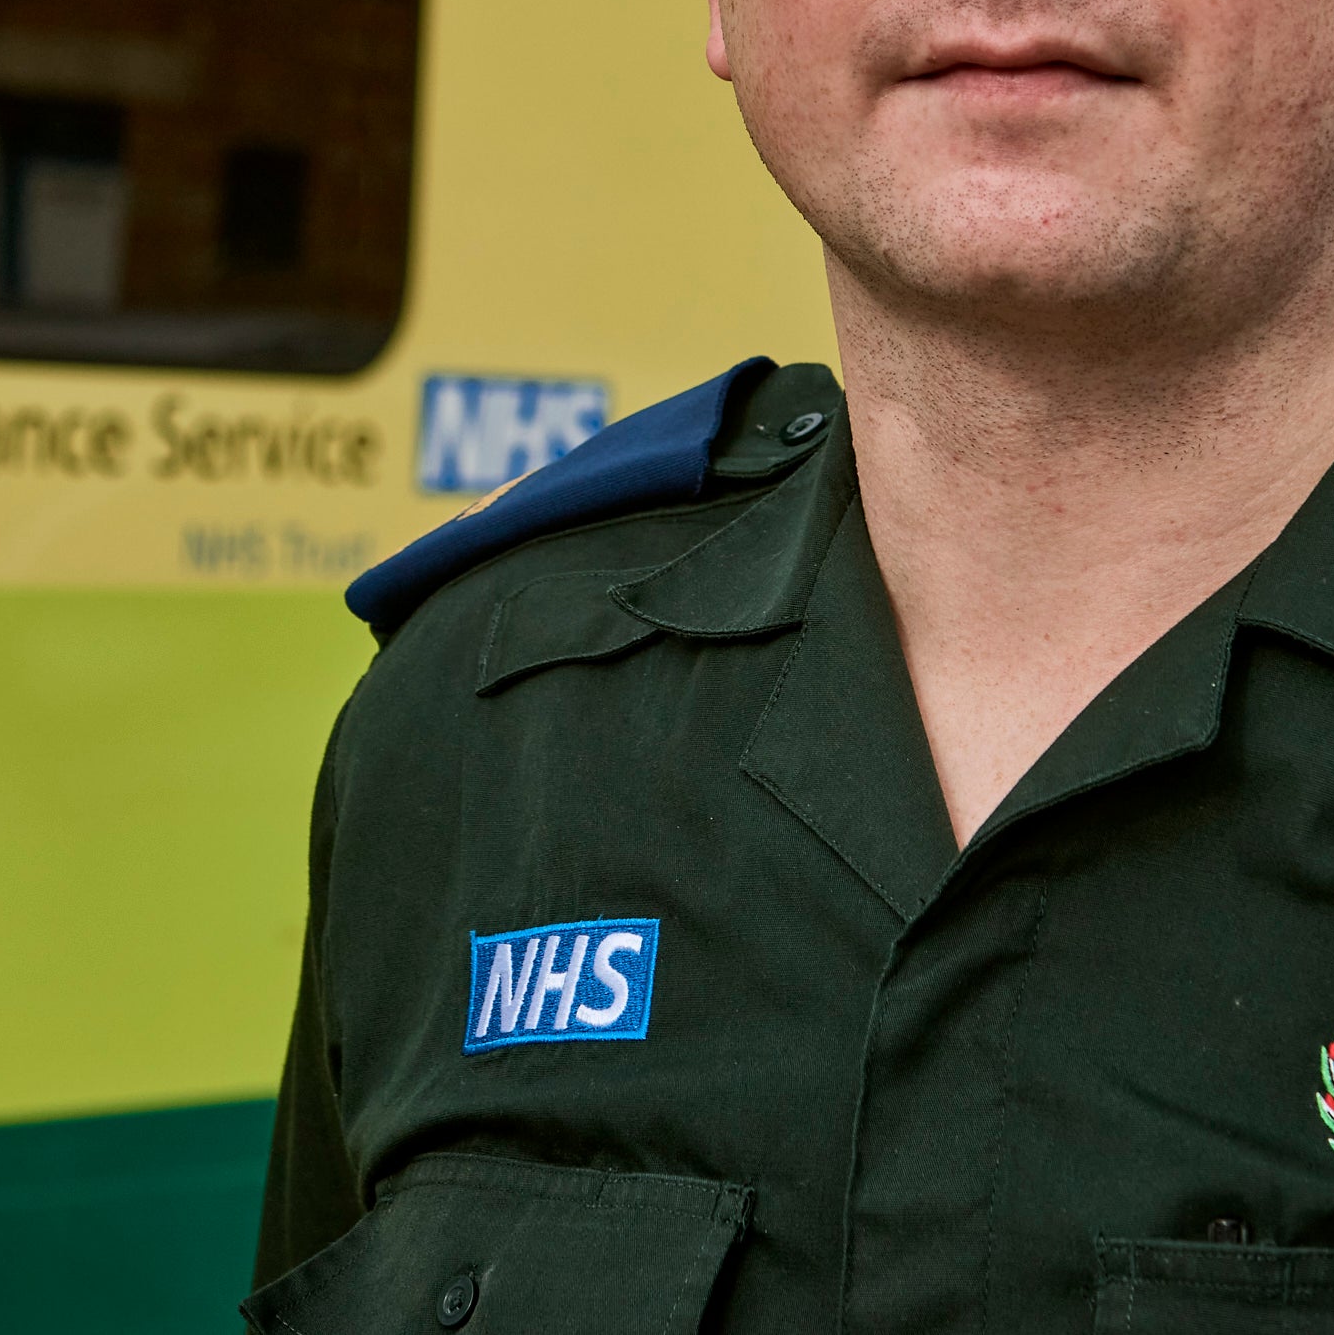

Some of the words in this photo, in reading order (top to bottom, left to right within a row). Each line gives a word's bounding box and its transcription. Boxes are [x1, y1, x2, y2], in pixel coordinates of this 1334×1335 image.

[152, 391, 382, 487] Service
[424, 379, 605, 485] NHS
[475, 932, 643, 1037] NHS
